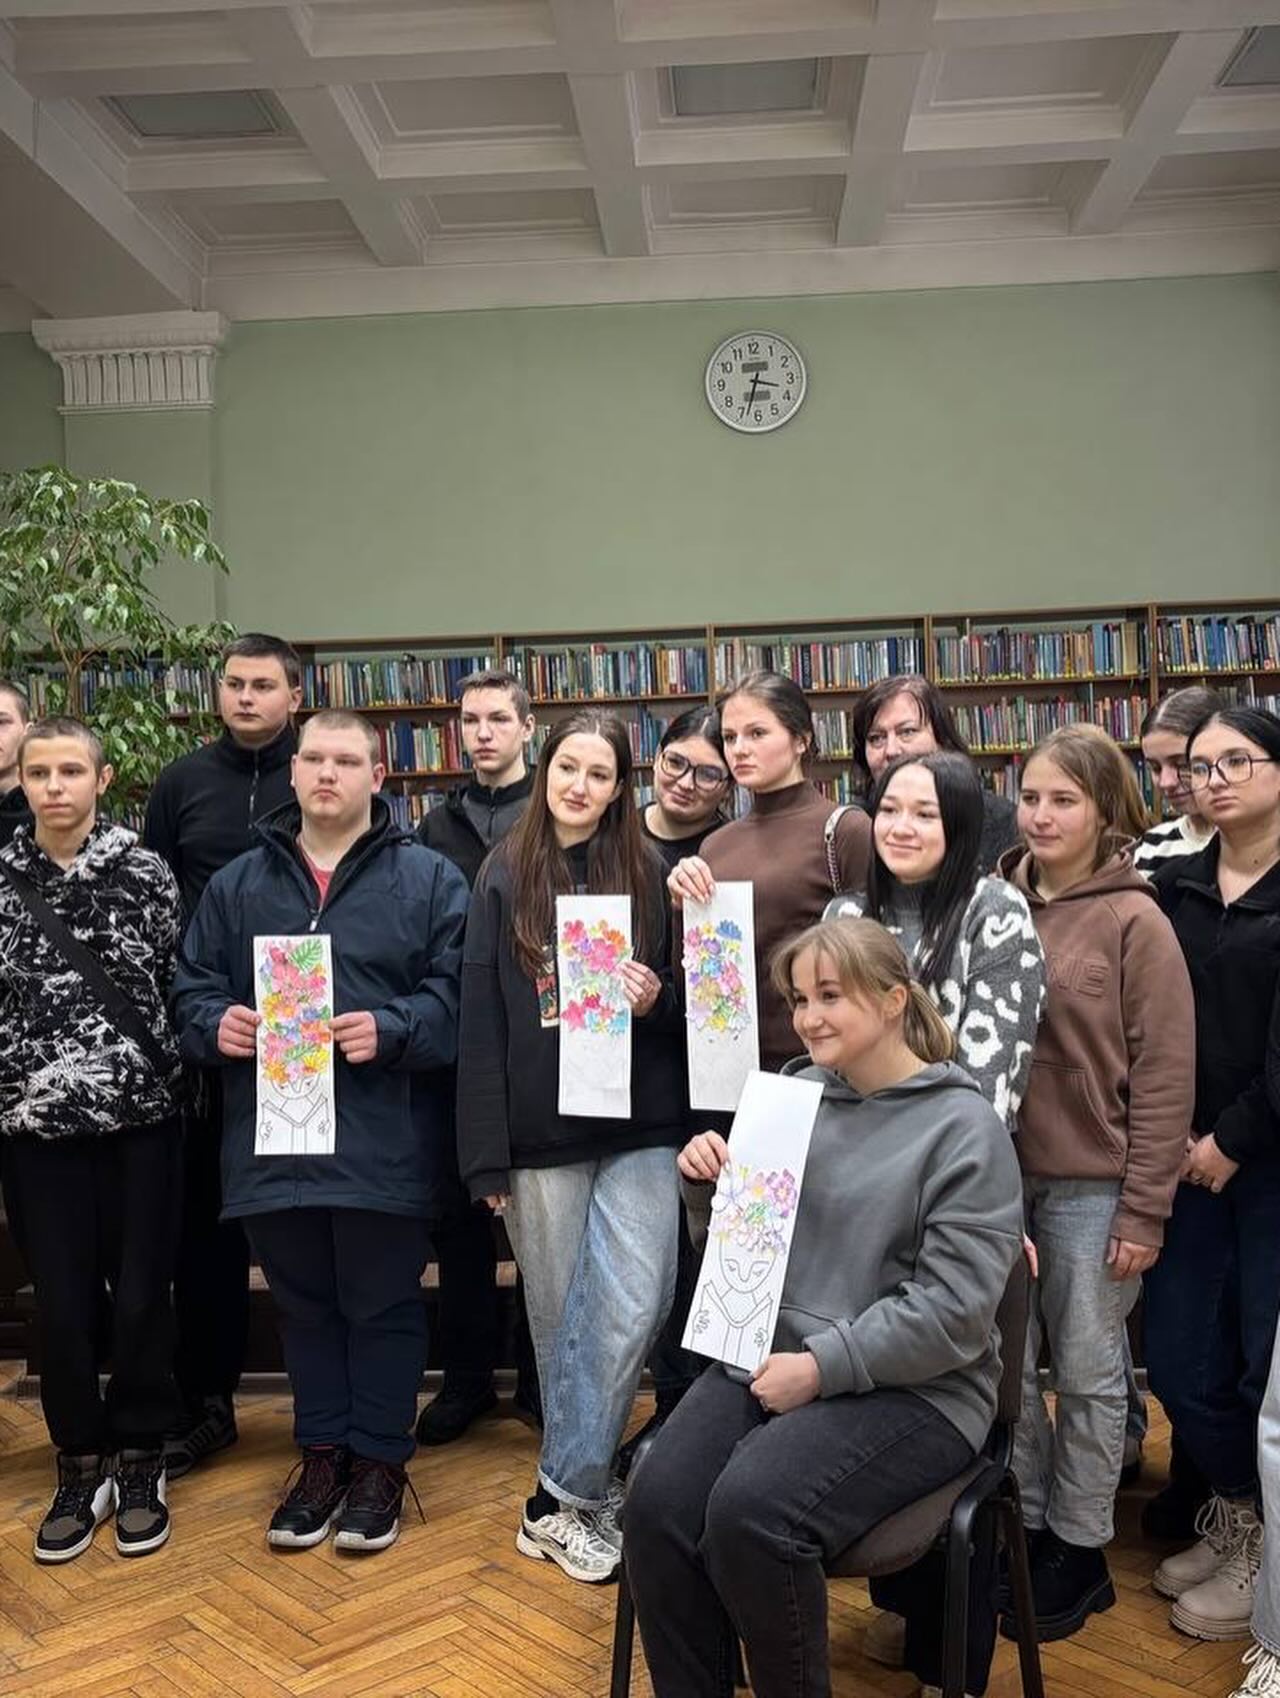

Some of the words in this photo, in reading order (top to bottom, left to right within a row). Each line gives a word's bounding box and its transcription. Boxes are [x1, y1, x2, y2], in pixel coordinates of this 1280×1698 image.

[748, 342, 759, 354] 12
[768, 345, 773, 357] 1
[733, 349, 742, 360] 11
[721, 362, 732, 373] 10
[780, 356, 789, 368] 2
[786, 373, 794, 384] 3
[717, 379, 725, 391] 9
[782, 390, 791, 401] 4
[725, 396, 733, 408] 8
[738, 407, 745, 418] 7
[770, 404, 779, 415] 5
[754, 410, 762, 422] 6
